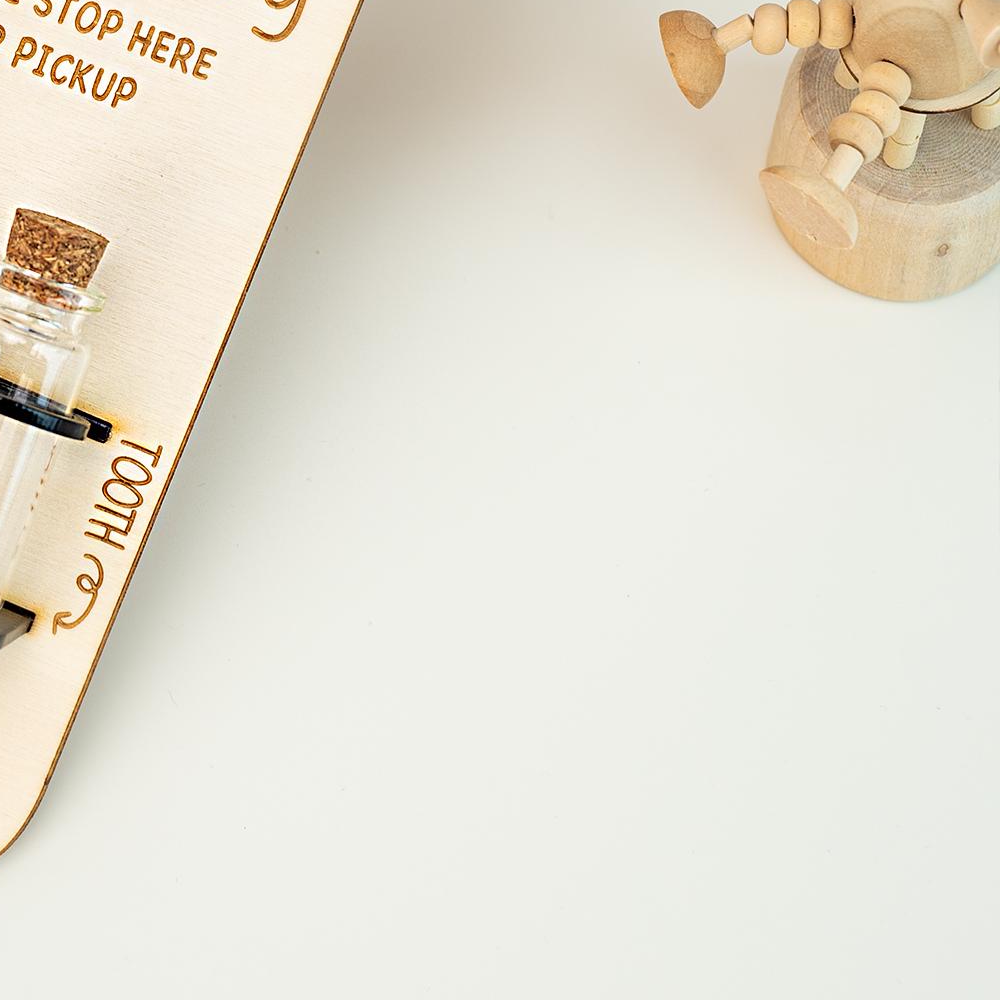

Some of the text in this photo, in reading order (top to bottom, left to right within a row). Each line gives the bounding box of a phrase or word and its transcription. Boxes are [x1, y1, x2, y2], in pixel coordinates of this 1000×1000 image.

[11, 36, 138, 108] PICKUP
[126, 20, 219, 81] HERE
[83, 439, 164, 551] TOOTH
